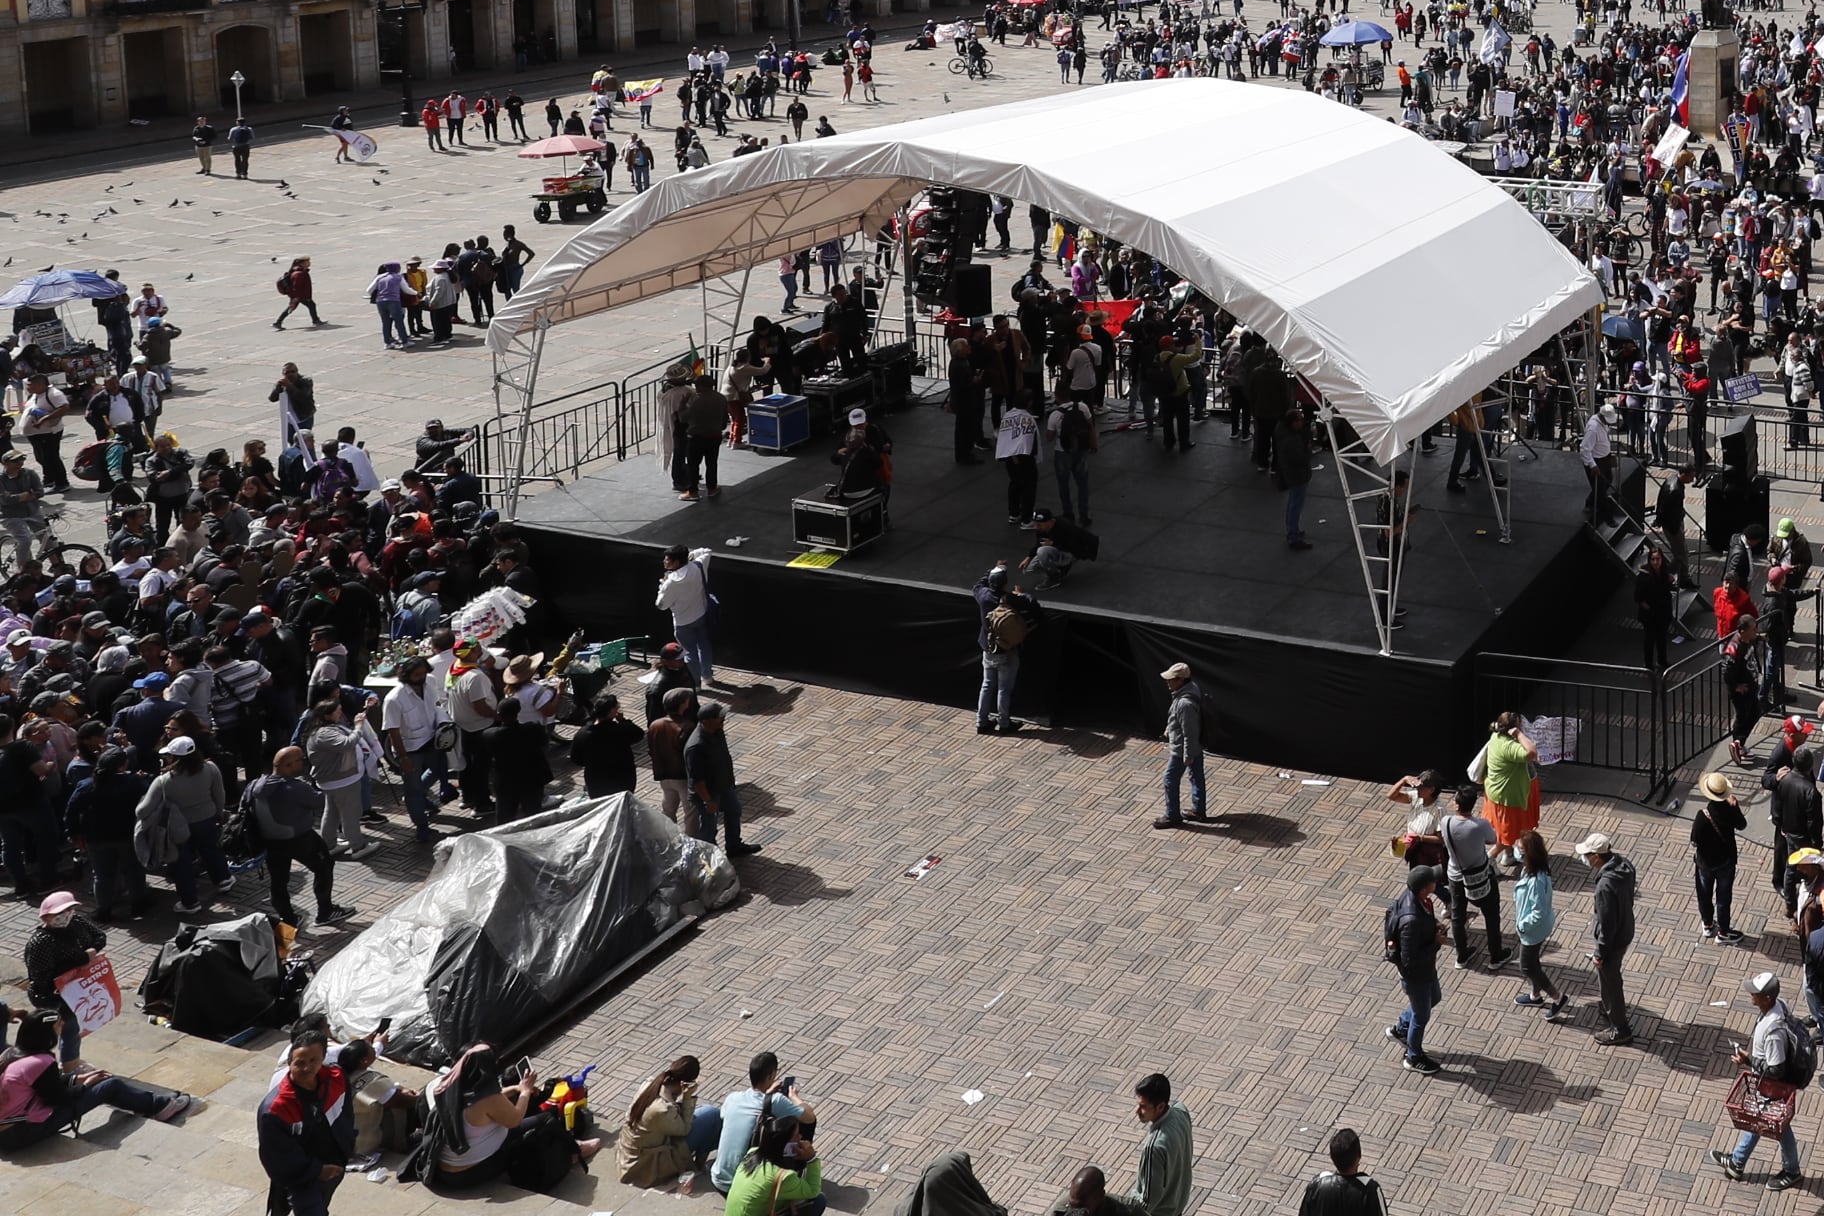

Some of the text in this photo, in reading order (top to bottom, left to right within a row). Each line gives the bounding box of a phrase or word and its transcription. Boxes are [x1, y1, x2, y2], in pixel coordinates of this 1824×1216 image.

[1727, 125, 1742, 162] CUT
[1728, 374, 1756, 387] ARTISTAS
[90, 961, 108, 973] CON
[81, 967, 109, 987] PETRO
